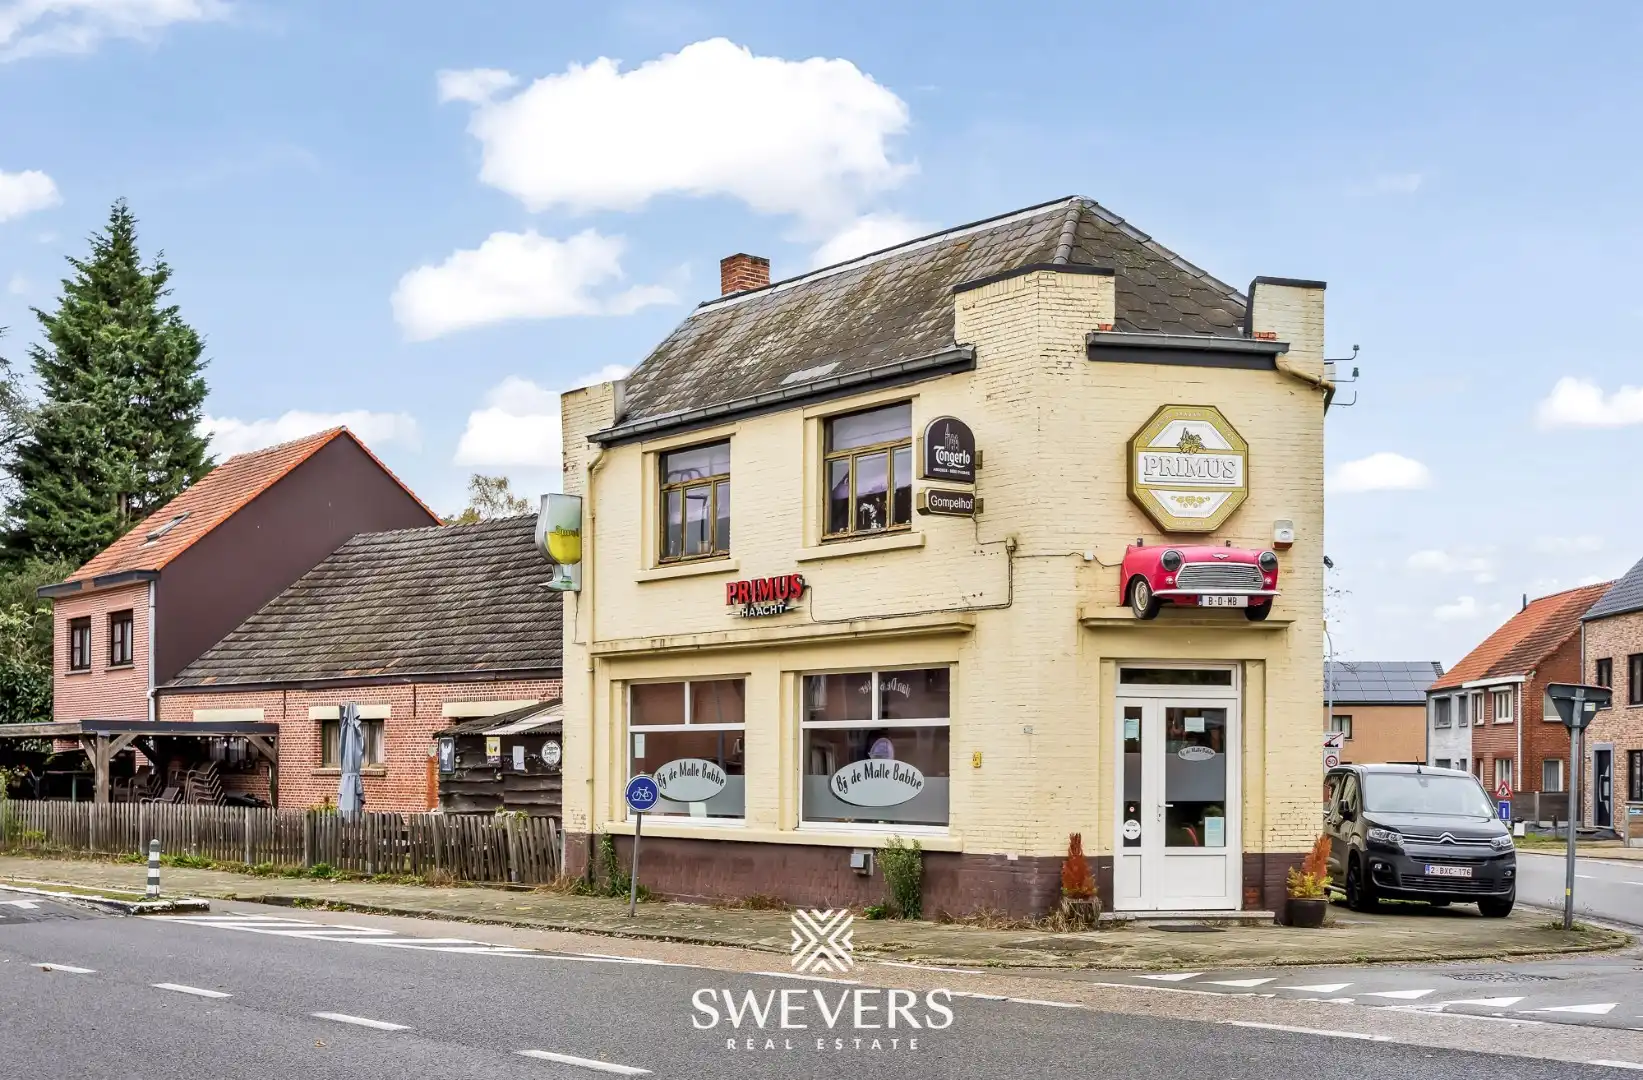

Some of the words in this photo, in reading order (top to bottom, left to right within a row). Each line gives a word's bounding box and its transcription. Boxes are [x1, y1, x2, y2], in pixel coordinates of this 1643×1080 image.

[933, 445, 971, 469] Tongerlo
[1144, 455, 1236, 478] PRIMUS
[930, 495, 974, 510] Gompelhof
[726, 574, 803, 605] PRIMUS
[741, 604, 785, 617] HAACHT
[669, 767, 677, 781] de
[679, 761, 699, 777] Malle
[701, 762, 725, 786] Babbe
[851, 769, 862, 785] de
[864, 762, 890, 780] Malle
[892, 763, 922, 790] Babbe
[1430, 866, 1471, 876] 2-BXC-176
